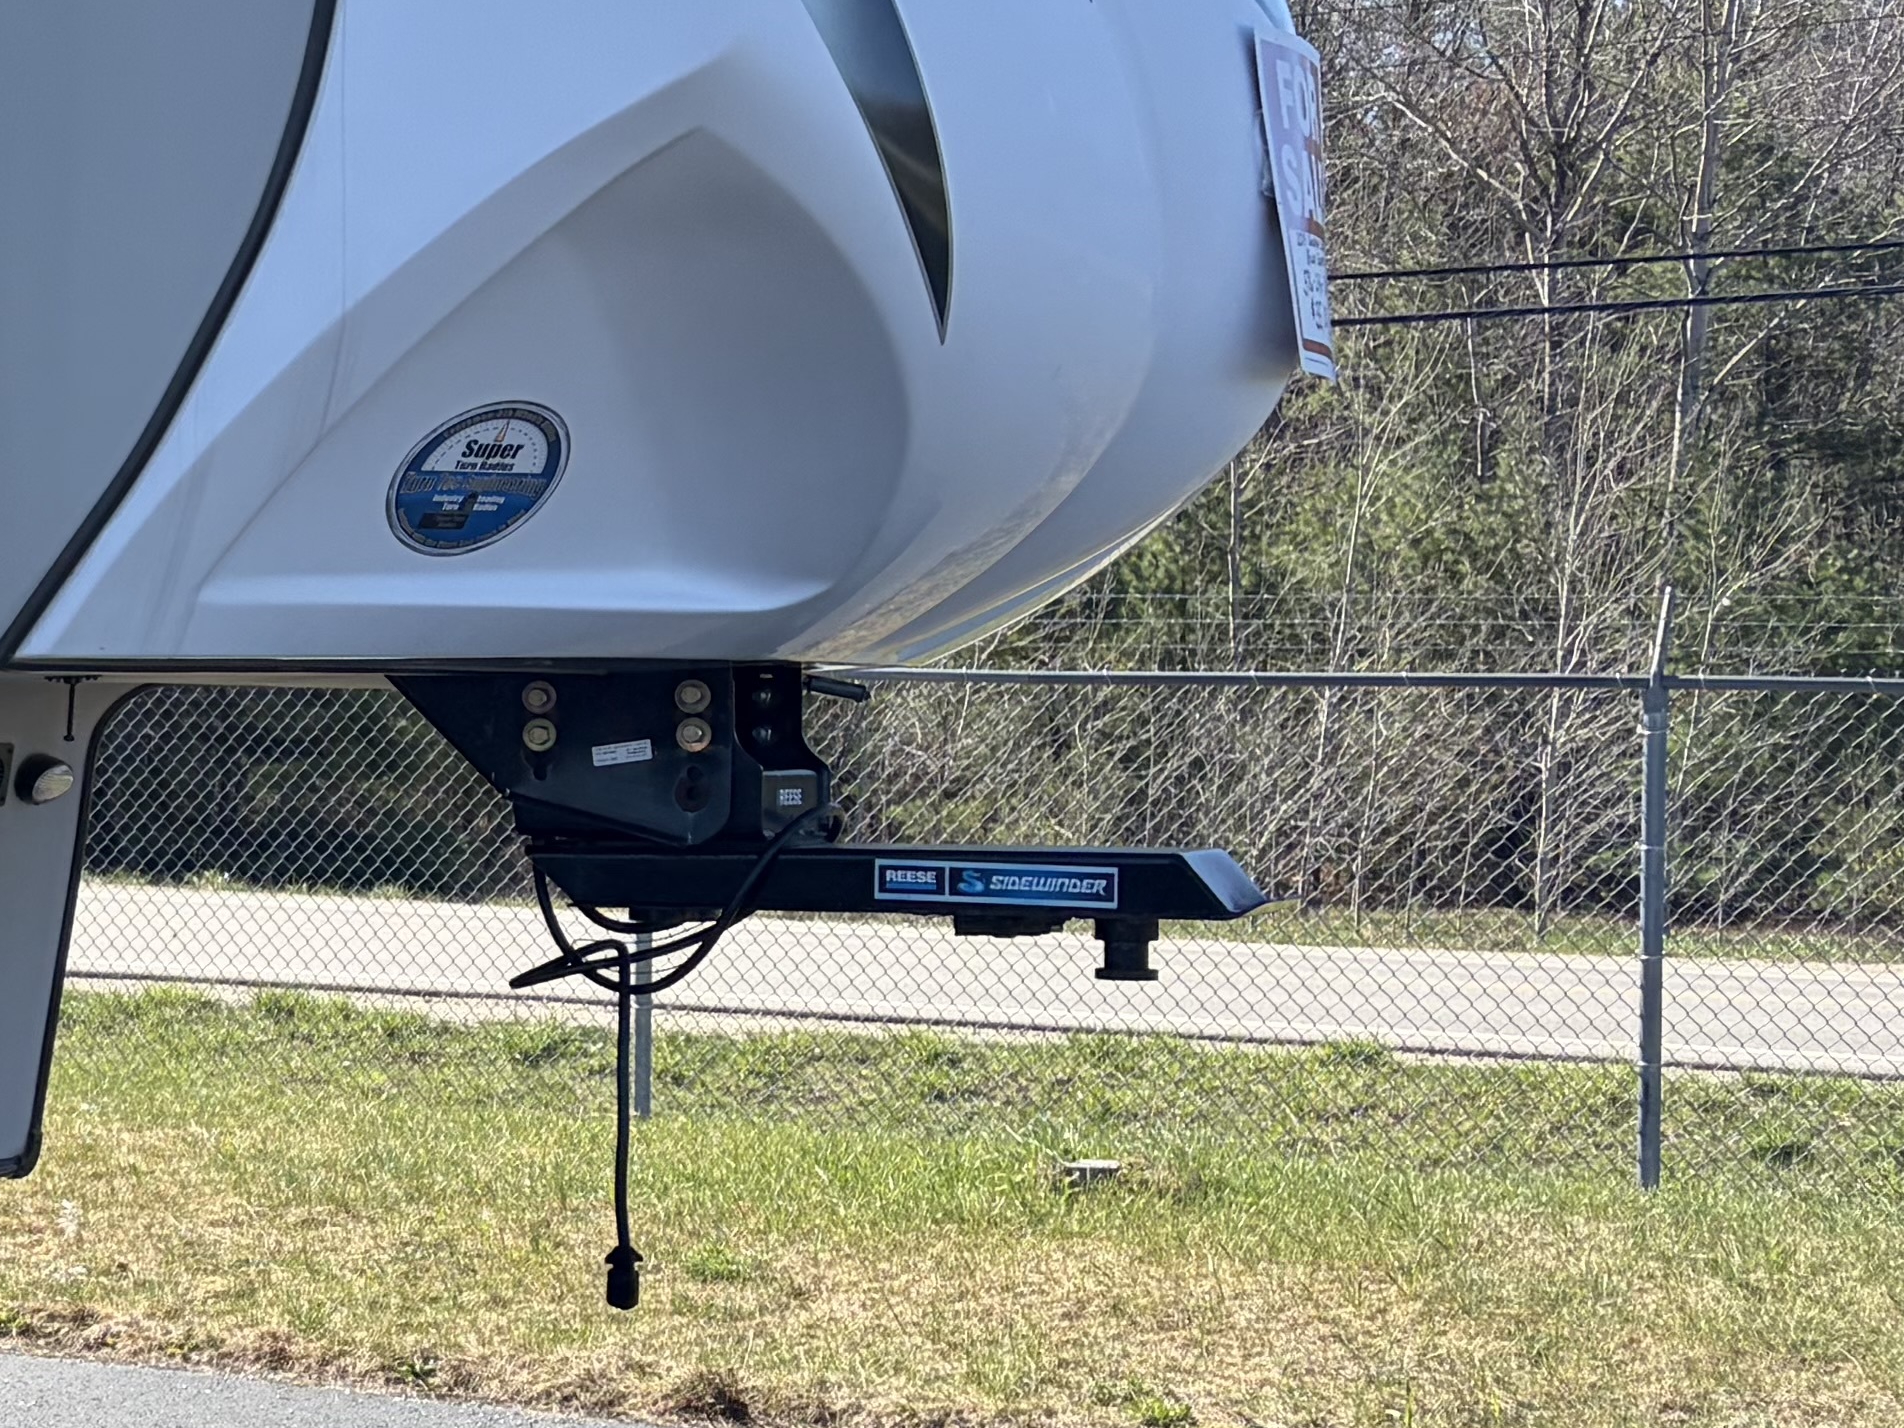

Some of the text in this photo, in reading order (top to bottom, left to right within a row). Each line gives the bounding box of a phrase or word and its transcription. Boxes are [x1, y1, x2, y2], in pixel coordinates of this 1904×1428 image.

[461, 438, 525, 461] Super
[454, 460, 515, 472] Turn Radius
[886, 869, 1107, 896] REESE SIDEWINDER
